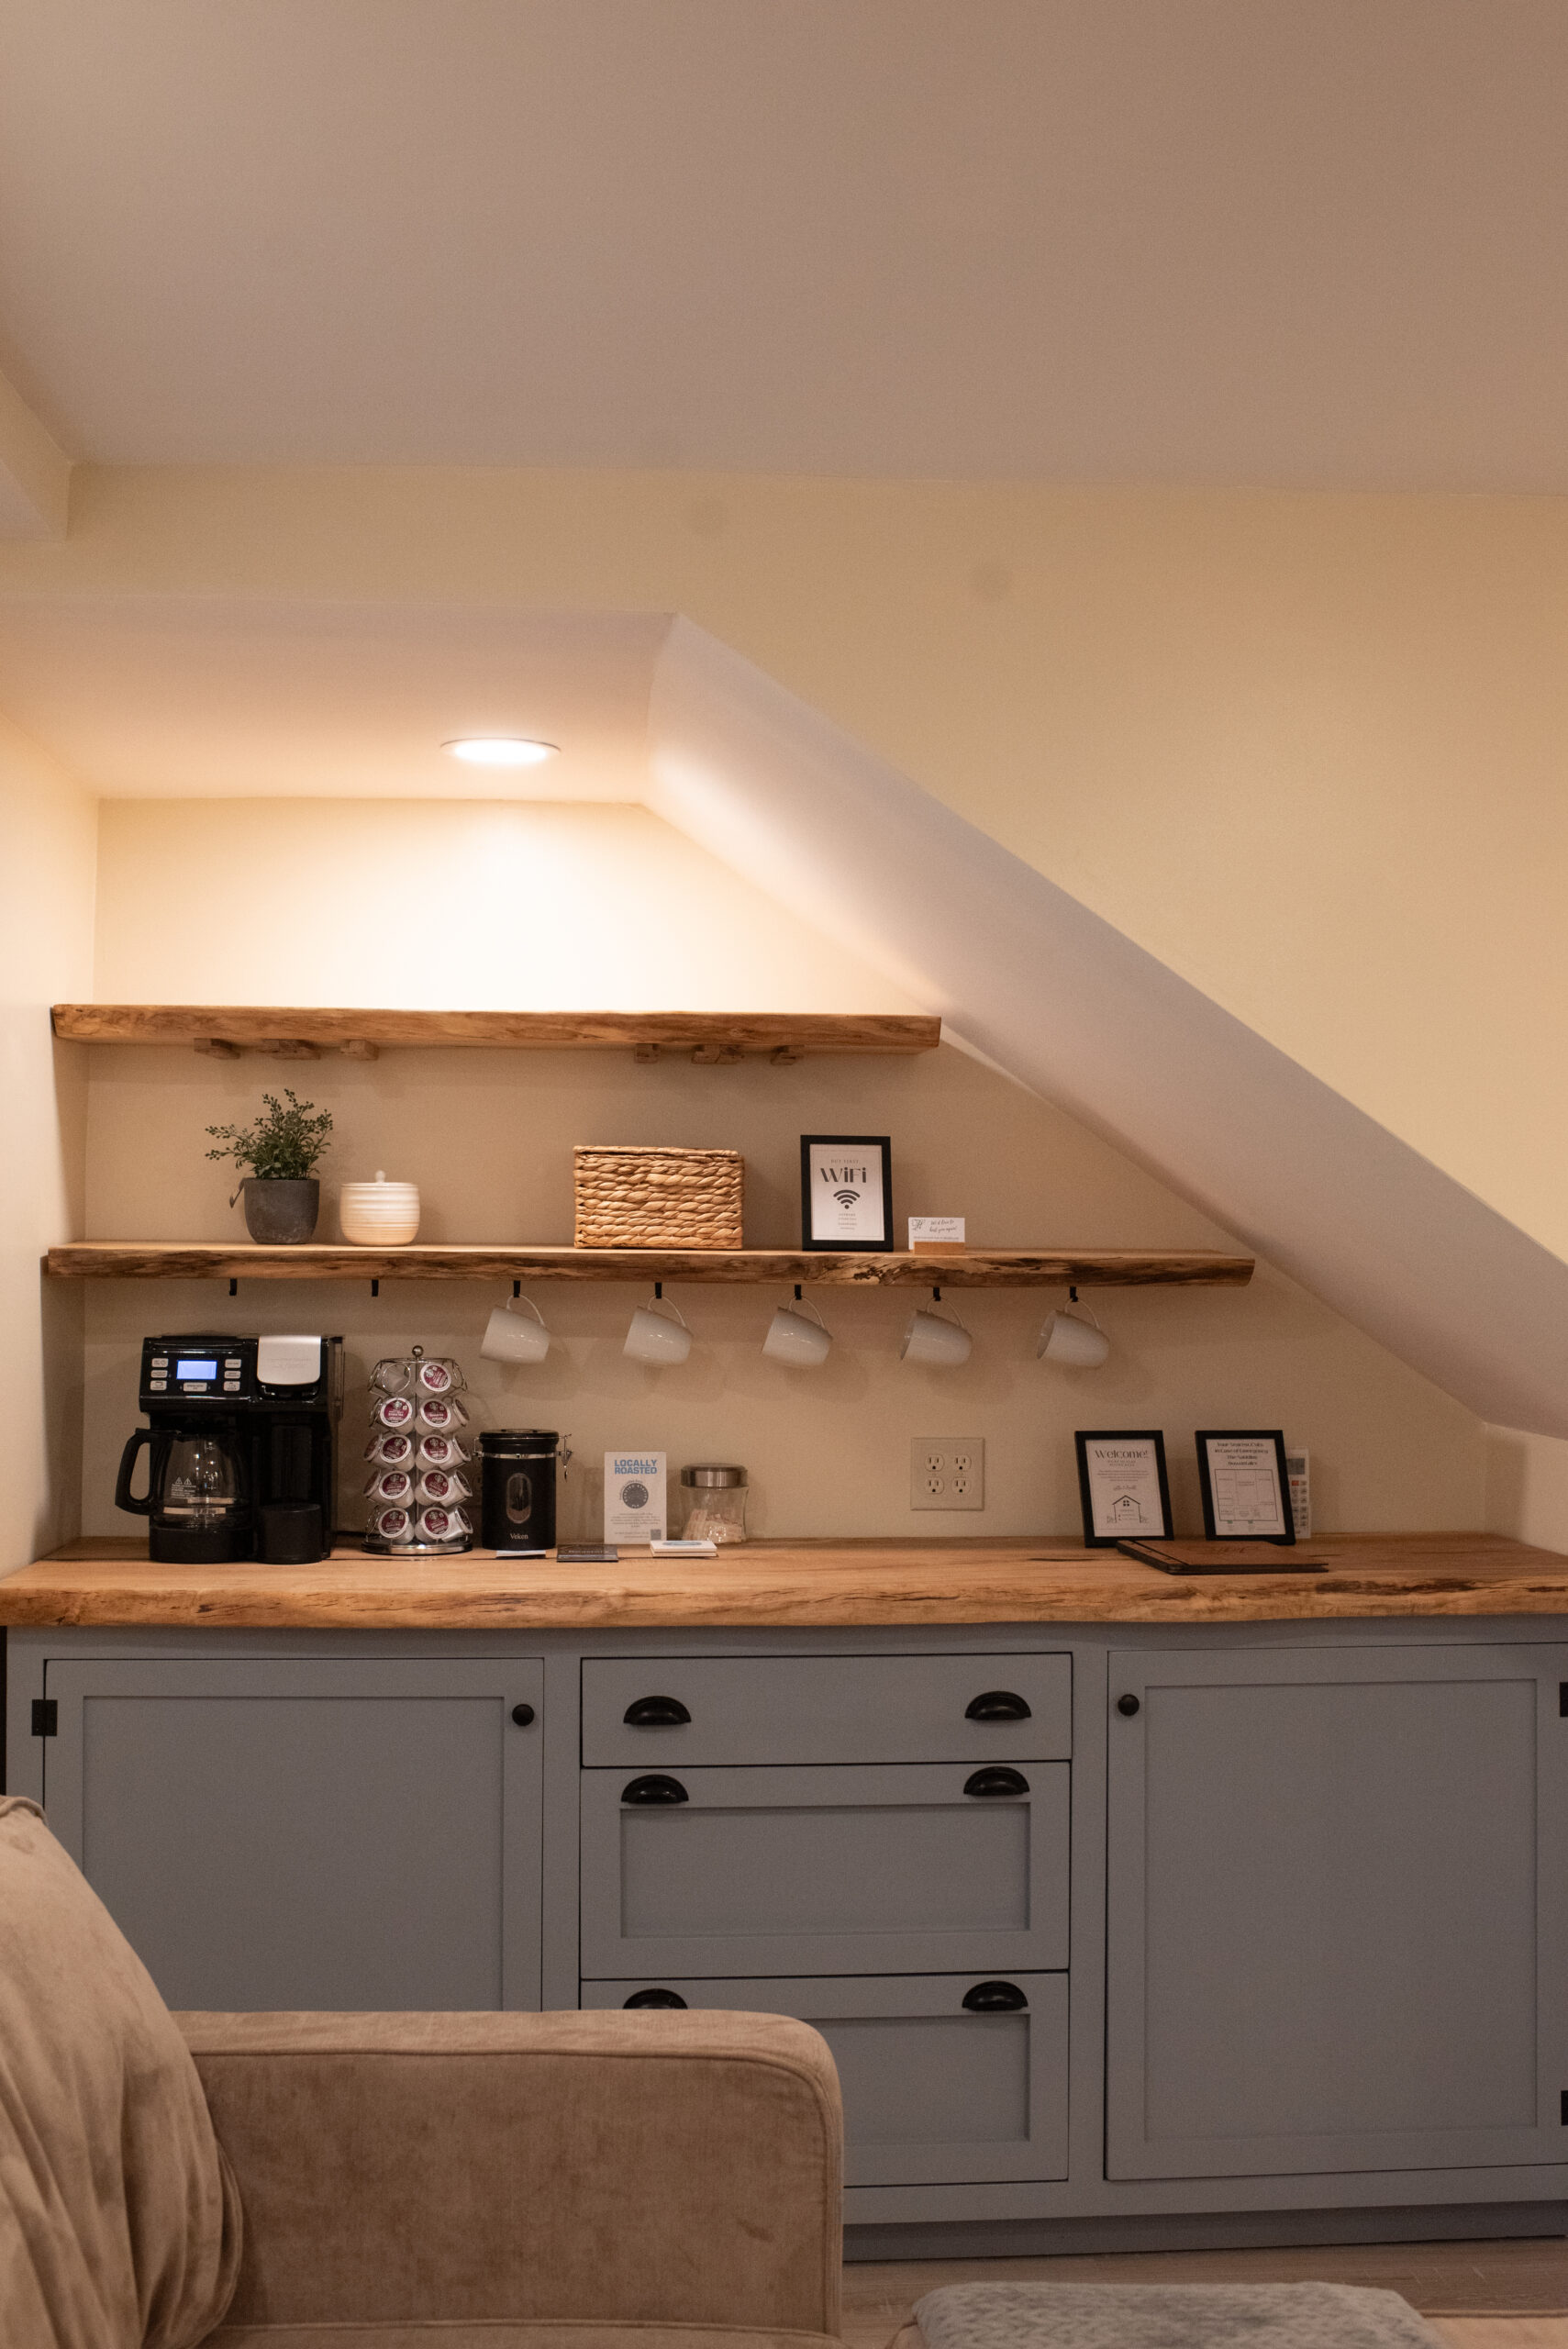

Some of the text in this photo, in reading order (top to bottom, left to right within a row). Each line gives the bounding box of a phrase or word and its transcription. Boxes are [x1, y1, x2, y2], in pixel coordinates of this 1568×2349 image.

[820, 1167, 867, 1183] WiFi
[1095, 1450, 1149, 1459] Welcome!
[615, 1466, 657, 1475] ROASTED
